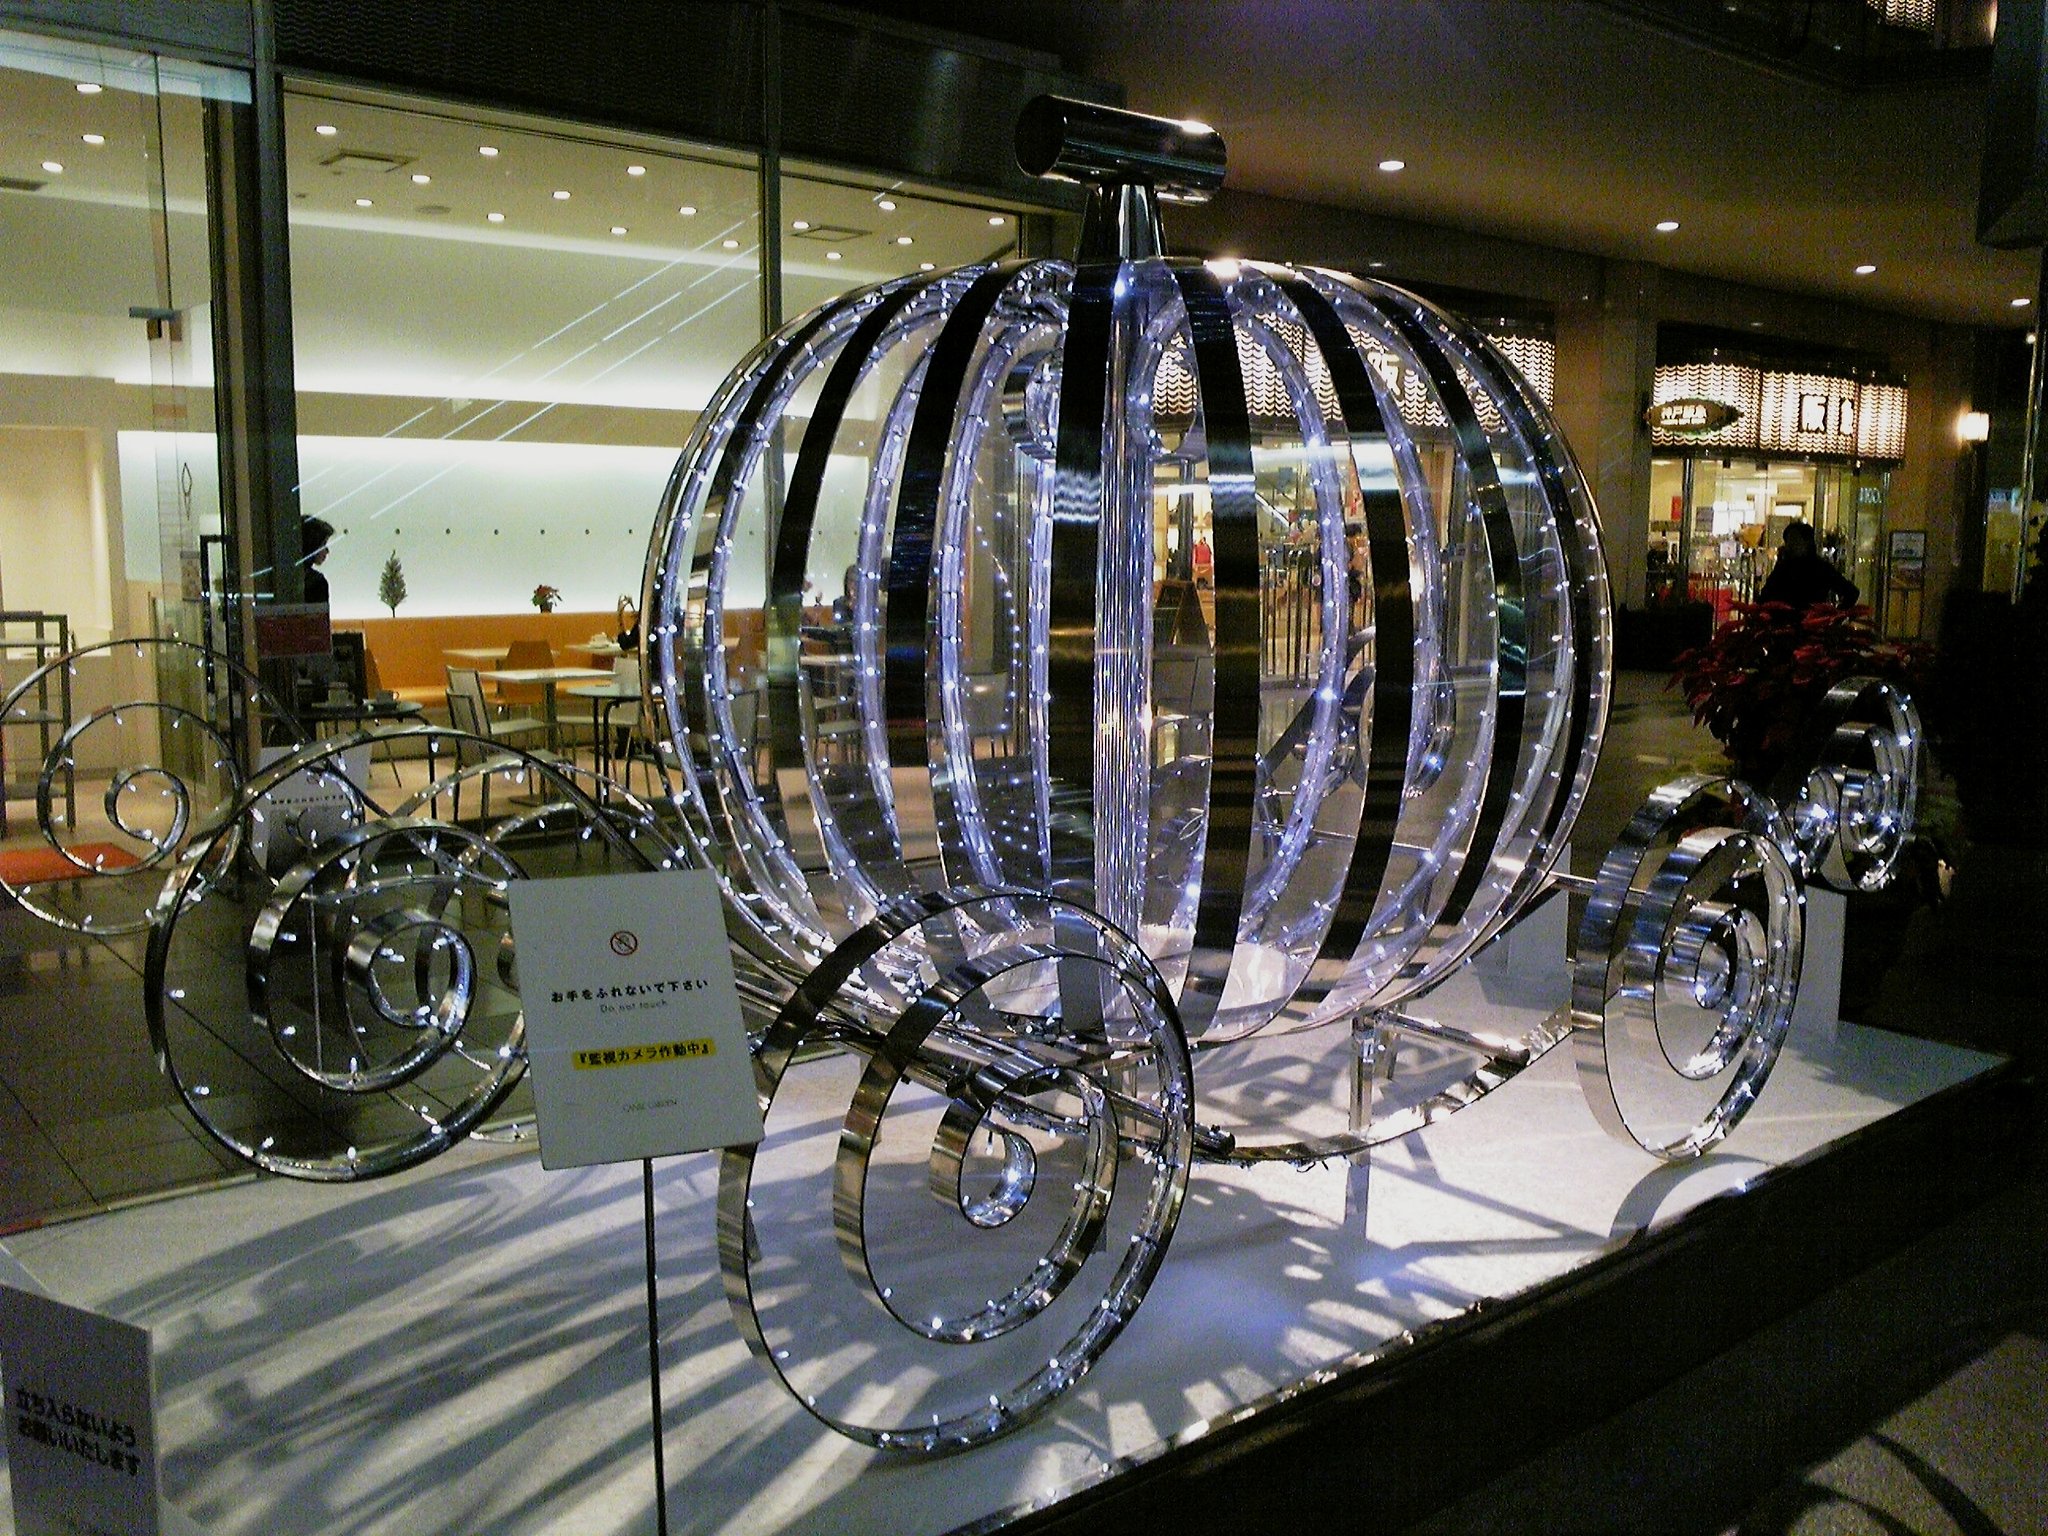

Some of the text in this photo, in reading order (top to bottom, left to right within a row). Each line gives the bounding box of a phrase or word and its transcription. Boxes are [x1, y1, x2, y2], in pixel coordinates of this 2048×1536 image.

[551, 979, 708, 1003] お手をふれないで下さい
[600, 1003, 615, 1014] Do
[639, 999, 668, 1010] touch
